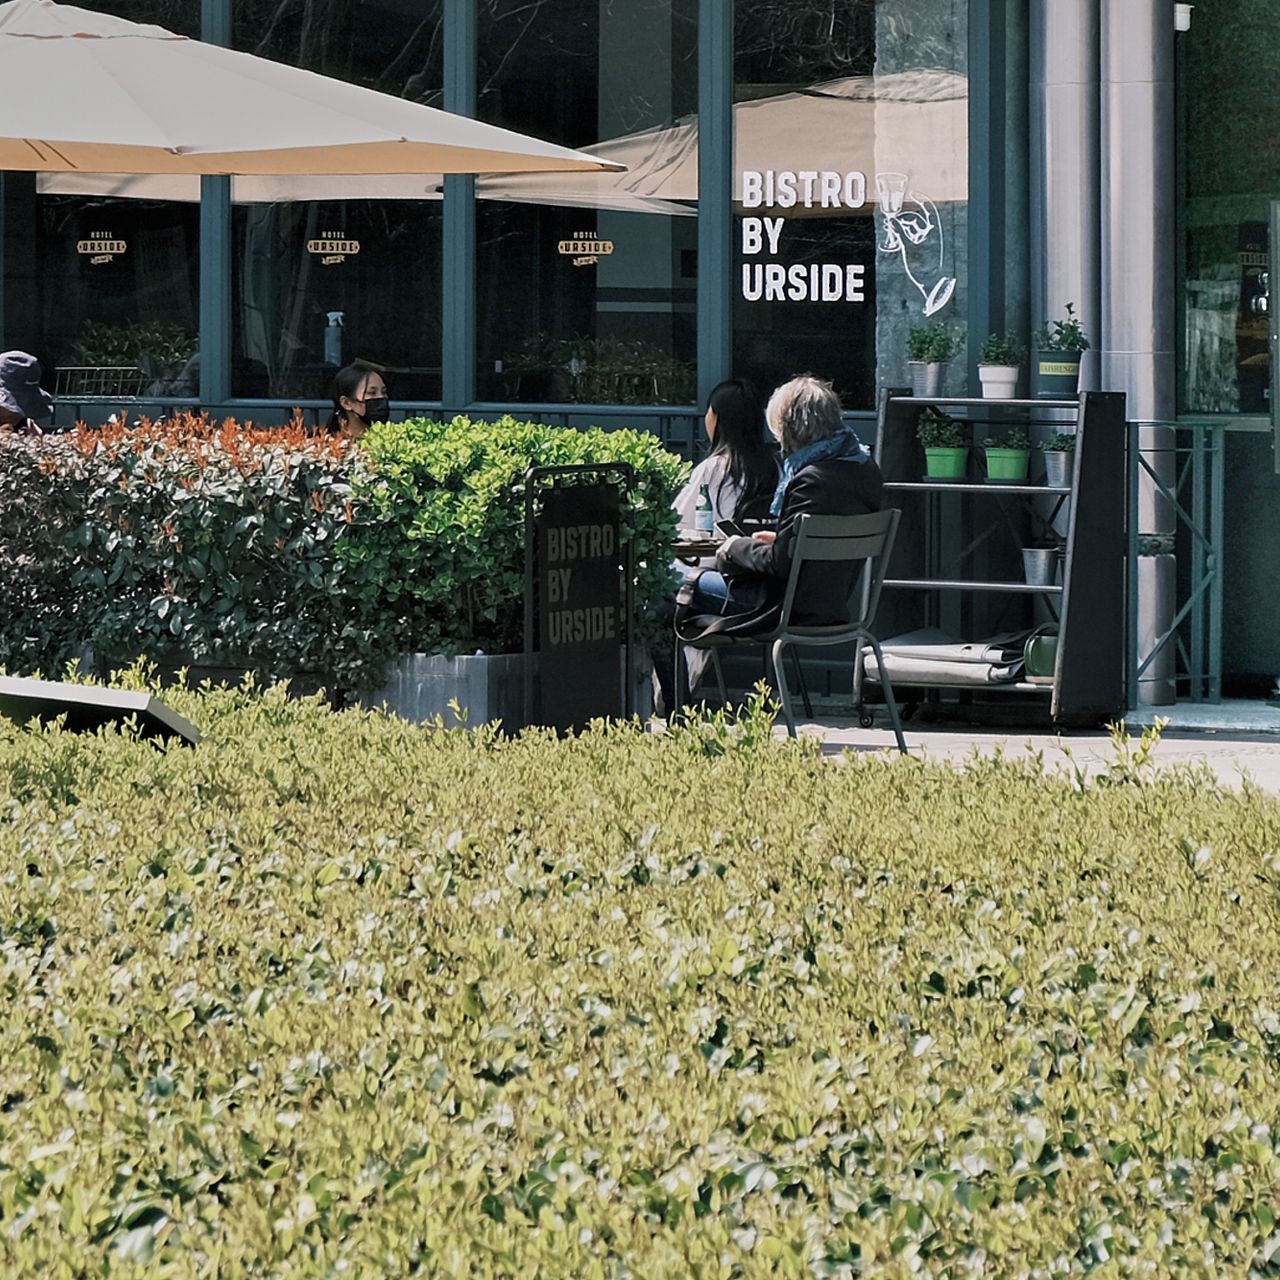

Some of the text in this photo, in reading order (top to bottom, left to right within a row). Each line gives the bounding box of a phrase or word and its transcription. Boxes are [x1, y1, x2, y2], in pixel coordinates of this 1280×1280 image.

[742, 170, 866, 209] BISTRO
[314, 241, 355, 252] URSIDE
[565, 242, 607, 252] URSIDE
[741, 217, 785, 255] BY
[741, 263, 865, 302] URSIDE
[547, 523, 615, 562] BISTRO
[547, 568, 572, 603] BY
[548, 606, 616, 645] URSIDE
